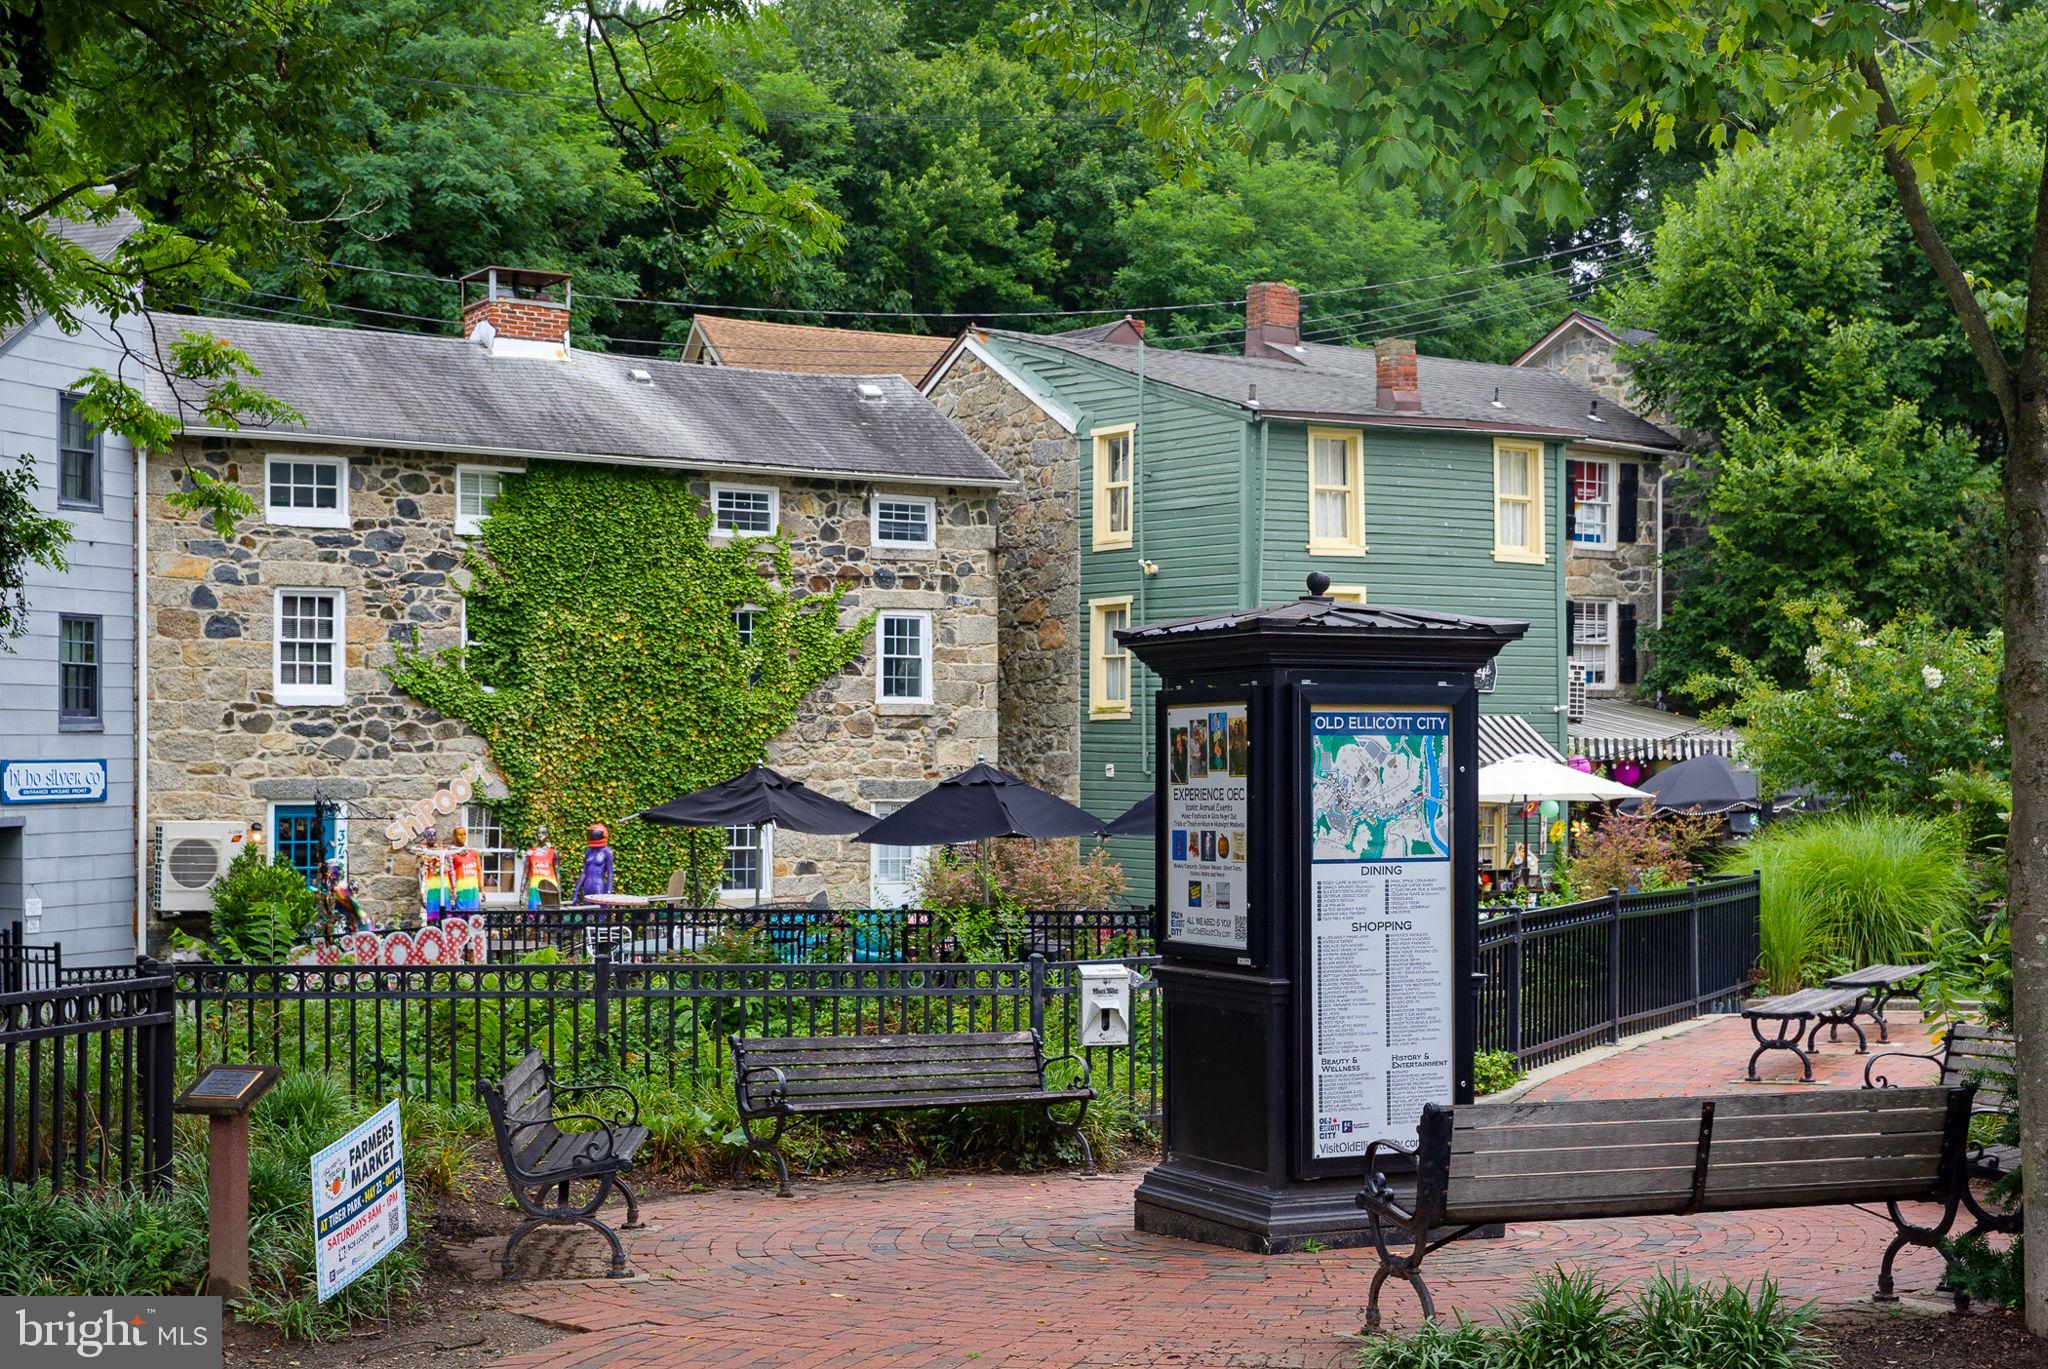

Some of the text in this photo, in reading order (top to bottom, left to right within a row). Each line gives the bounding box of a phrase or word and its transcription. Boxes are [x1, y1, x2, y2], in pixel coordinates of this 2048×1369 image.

[1314, 716, 1447, 729] OLD ELLICOTT CITY
[9, 769, 20, 786] hi
[25, 769, 41, 786] ho
[1173, 787, 1245, 801] EXPERIENCE OEC
[1200, 803, 1215, 811] Annual
[1216, 803, 1233, 811] Events
[1361, 865, 1402, 876] DINING
[1351, 920, 1412, 932] SHOPPING
[1170, 928, 1183, 936] CITY
[1321, 1056, 1358, 1066] BEAUTY &
[1391, 1054, 1421, 1062] HISTORY
[1321, 1065, 1360, 1073] WELLNESS
[1391, 1060, 1448, 1069] ENTERTAINMENT
[1319, 1132, 1336, 1140] CITY
[349, 1120, 394, 1166] FARMERS
[351, 1140, 395, 1189] MARKET
[320, 1217, 328, 1234] AT
[346, 1195, 362, 1216] PARK
[327, 1215, 367, 1251] SATURDAYS
